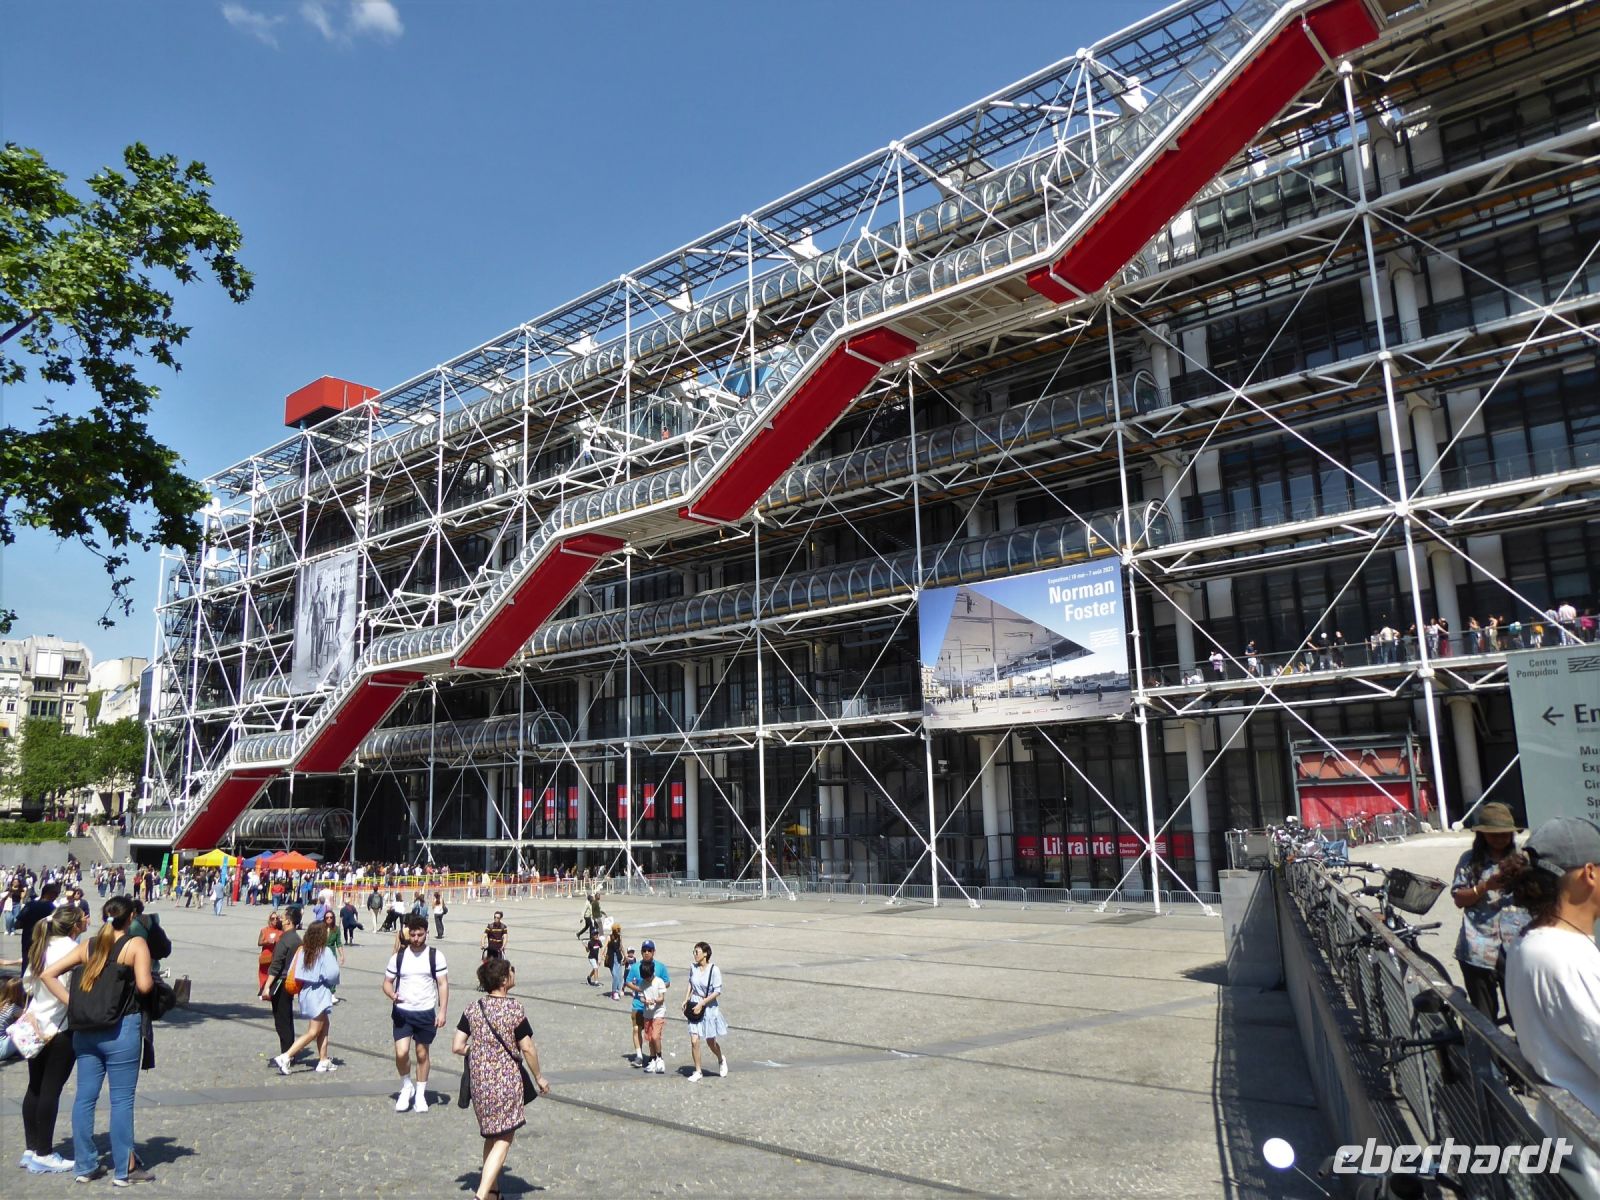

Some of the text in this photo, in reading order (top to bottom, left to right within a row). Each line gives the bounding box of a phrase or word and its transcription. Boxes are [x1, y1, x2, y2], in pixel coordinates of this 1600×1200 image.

[1103, 565, 1114, 573] 2023
[1049, 580, 1115, 604] Norman
[1065, 600, 1117, 622] Foster
[1529, 659, 1557, 668] Centre
[1516, 667, 1559, 678] Pompidou
